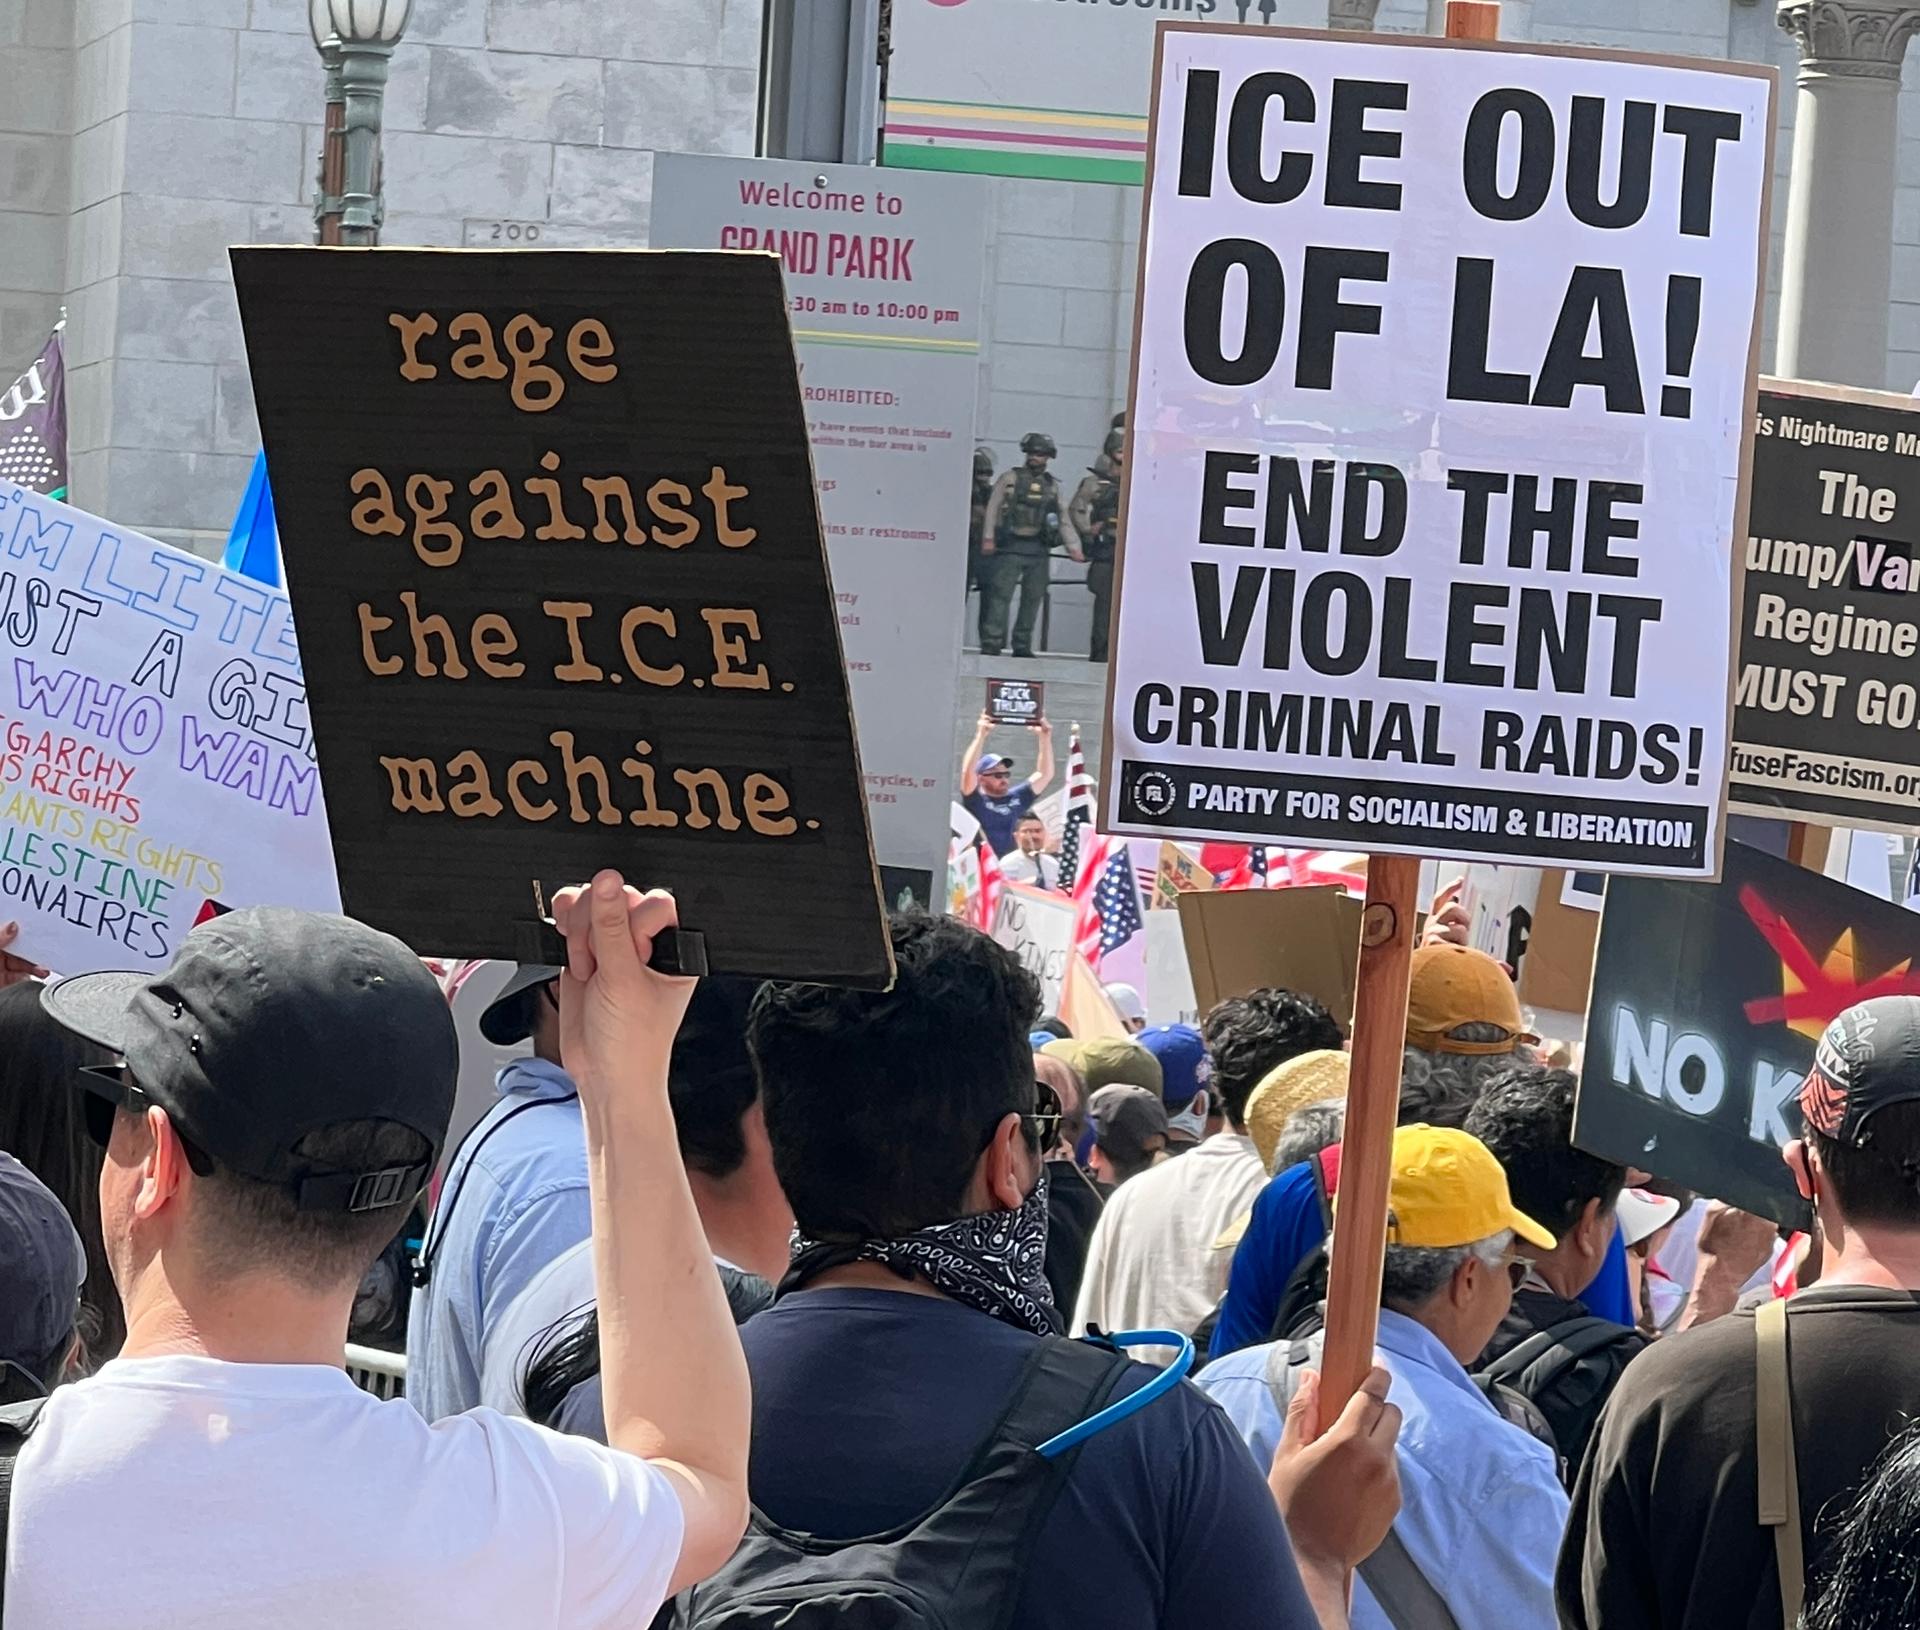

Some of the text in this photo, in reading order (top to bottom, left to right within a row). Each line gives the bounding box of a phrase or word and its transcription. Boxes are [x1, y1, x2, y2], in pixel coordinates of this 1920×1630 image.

[1178, 68, 1742, 238] ICE OUT
[491, 223, 540, 240] 200
[739, 180, 902, 216] Welcome to
[827, 233, 915, 282] PARK
[822, 301, 847, 316] am
[853, 301, 870, 316] to
[877, 302, 928, 319] 10:00
[934, 308, 960, 325] pm
[1183, 237, 1702, 420] OF LA!
[389, 312, 618, 412] rage
[804, 387, 899, 407] ROHIBITED:
[1779, 416, 1889, 452] Nightmare
[350, 450, 757, 567] against
[1199, 450, 1644, 578] END THE
[1818, 469, 1897, 523] The
[81, 532, 304, 676] LITE
[357, 592, 794, 692] the I.C.E.
[1190, 561, 1663, 699] VIOLENT
[1753, 593, 1919, 657] Regime
[14, 656, 318, 817] WHO WAN
[131, 628, 184, 699] A
[208, 658, 318, 764] GI
[992, 698, 1037, 714] TRUMP
[1132, 682, 1704, 786] CRIMINAL RAIDS!
[0, 712, 136, 794] GARCHY
[31, 762, 141, 824] RIGHTS
[379, 730, 821, 836] machine.
[1730, 746, 1920, 801] fuseFascism.or
[1188, 782, 1280, 817] PARTY
[1286, 789, 1339, 822] FOR
[1349, 795, 1498, 836] SOCIALISM
[1505, 807, 1528, 838] &
[1535, 811, 1694, 850] LIBERATION
[1, 826, 176, 919] LESTINE
[90, 818, 224, 897] RIGHTS
[999, 897, 1027, 932] NO
[1611, 1003, 1727, 1118] NO
